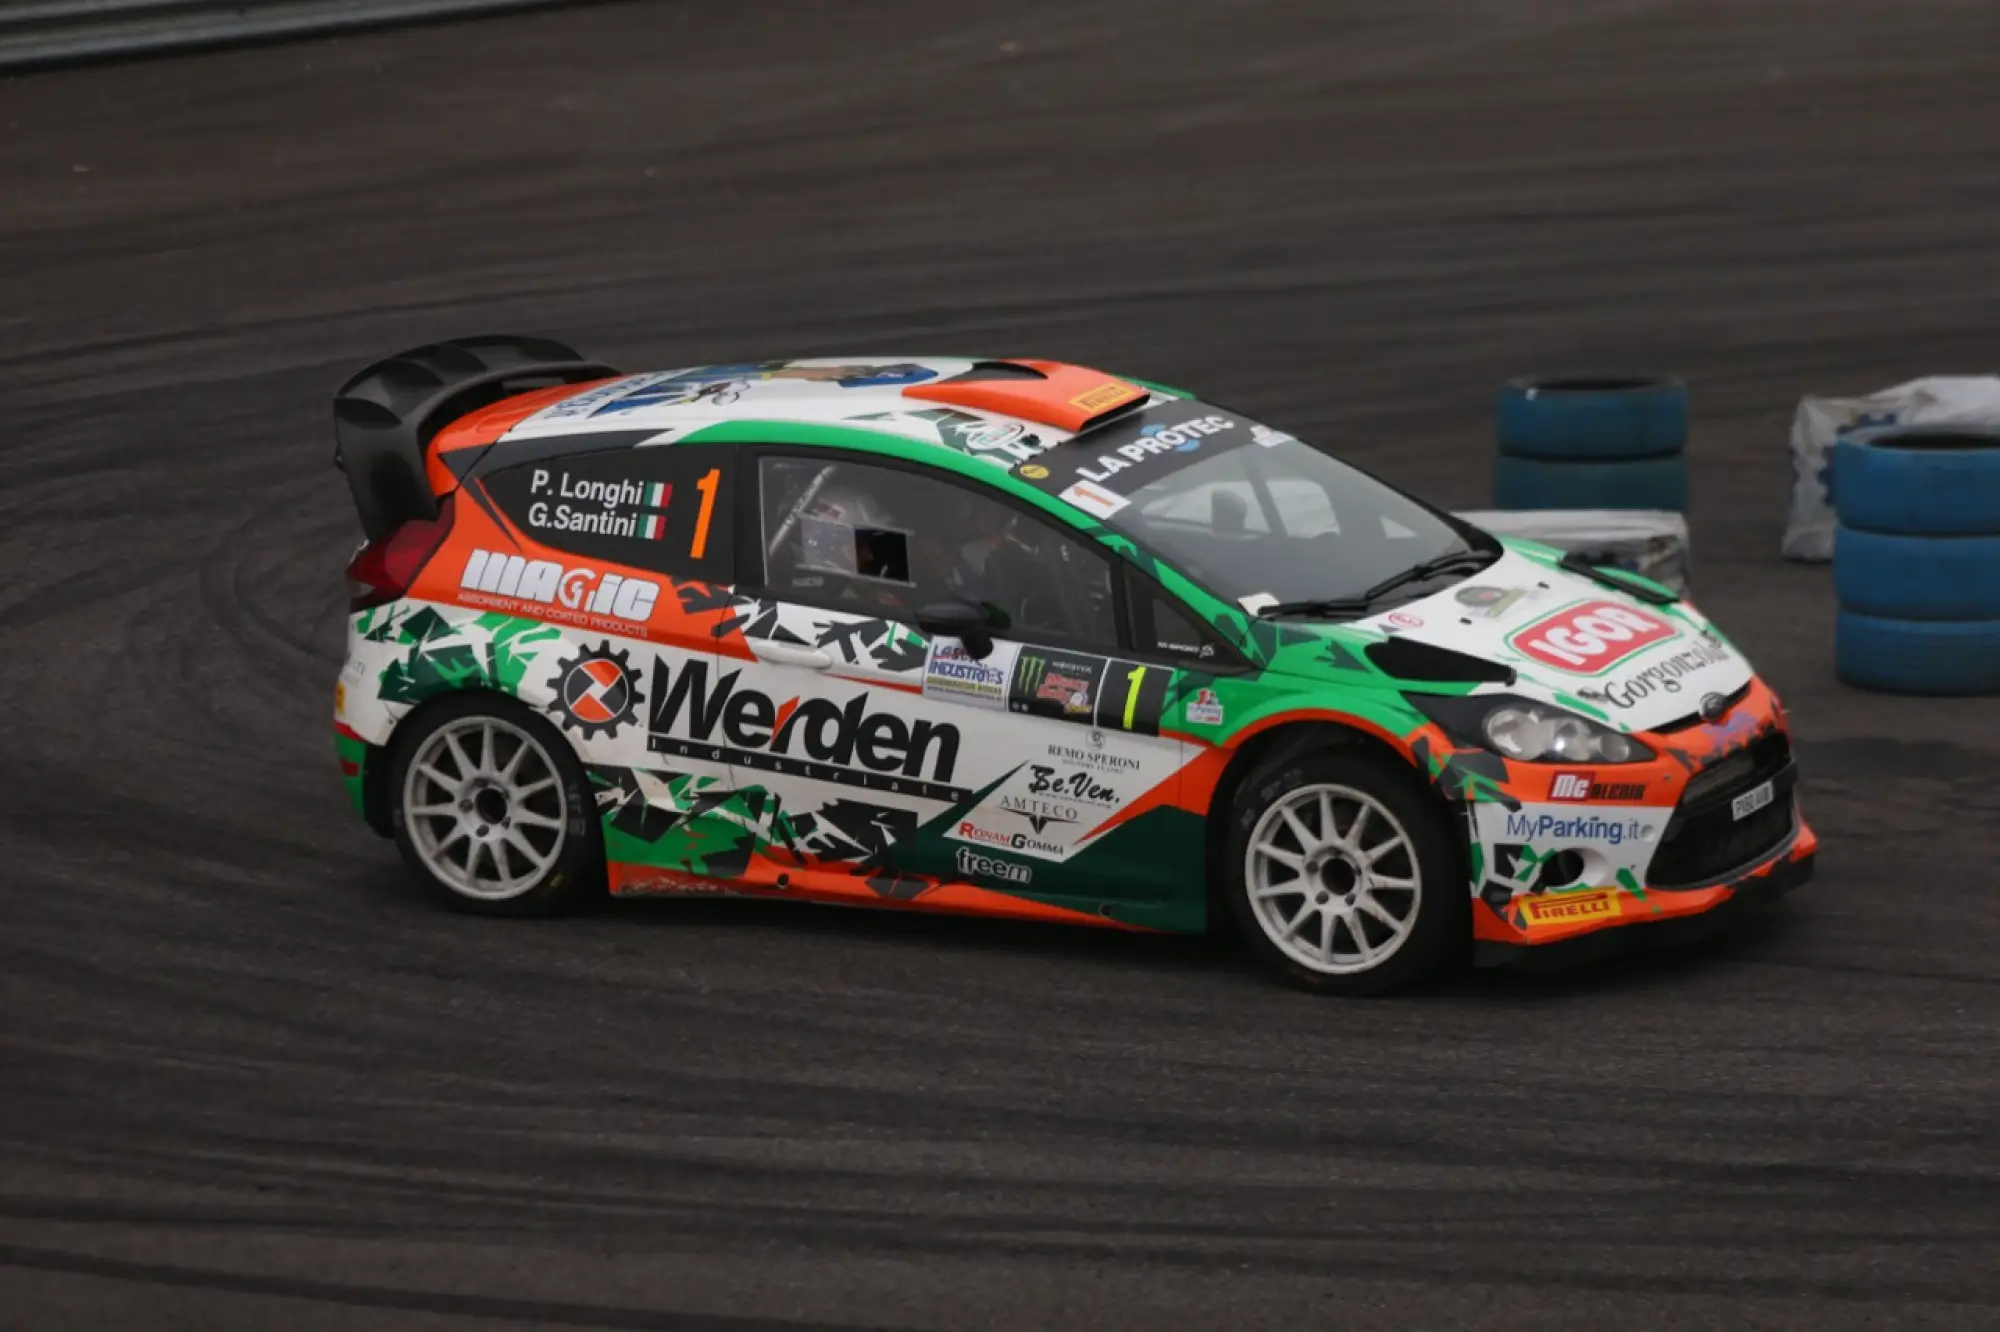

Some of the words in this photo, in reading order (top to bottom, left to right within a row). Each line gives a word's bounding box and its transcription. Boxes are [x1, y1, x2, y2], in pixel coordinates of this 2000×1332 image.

[1075, 455, 1133, 483] LA
[1116, 415, 1236, 463] PROTEC
[530, 469, 553, 496] P.
[559, 472, 643, 508] Longhi
[1073, 485, 1115, 508] 1
[529, 502, 637, 537] G.Santini
[690, 468, 720, 559] 1
[520, 601, 544, 617] AND
[590, 616, 648, 637] PRODUCTS
[1528, 606, 1660, 666] IGOR
[1122, 664, 1148, 730] 1
[648, 653, 961, 783] Werden
[1048, 744, 1085, 761] REMO
[1087, 751, 1140, 772] SPERONI
[1000, 794, 1078, 820] AMTECO
[956, 846, 1032, 883] freem
[1530, 891, 1610, 919] PIRELLI
